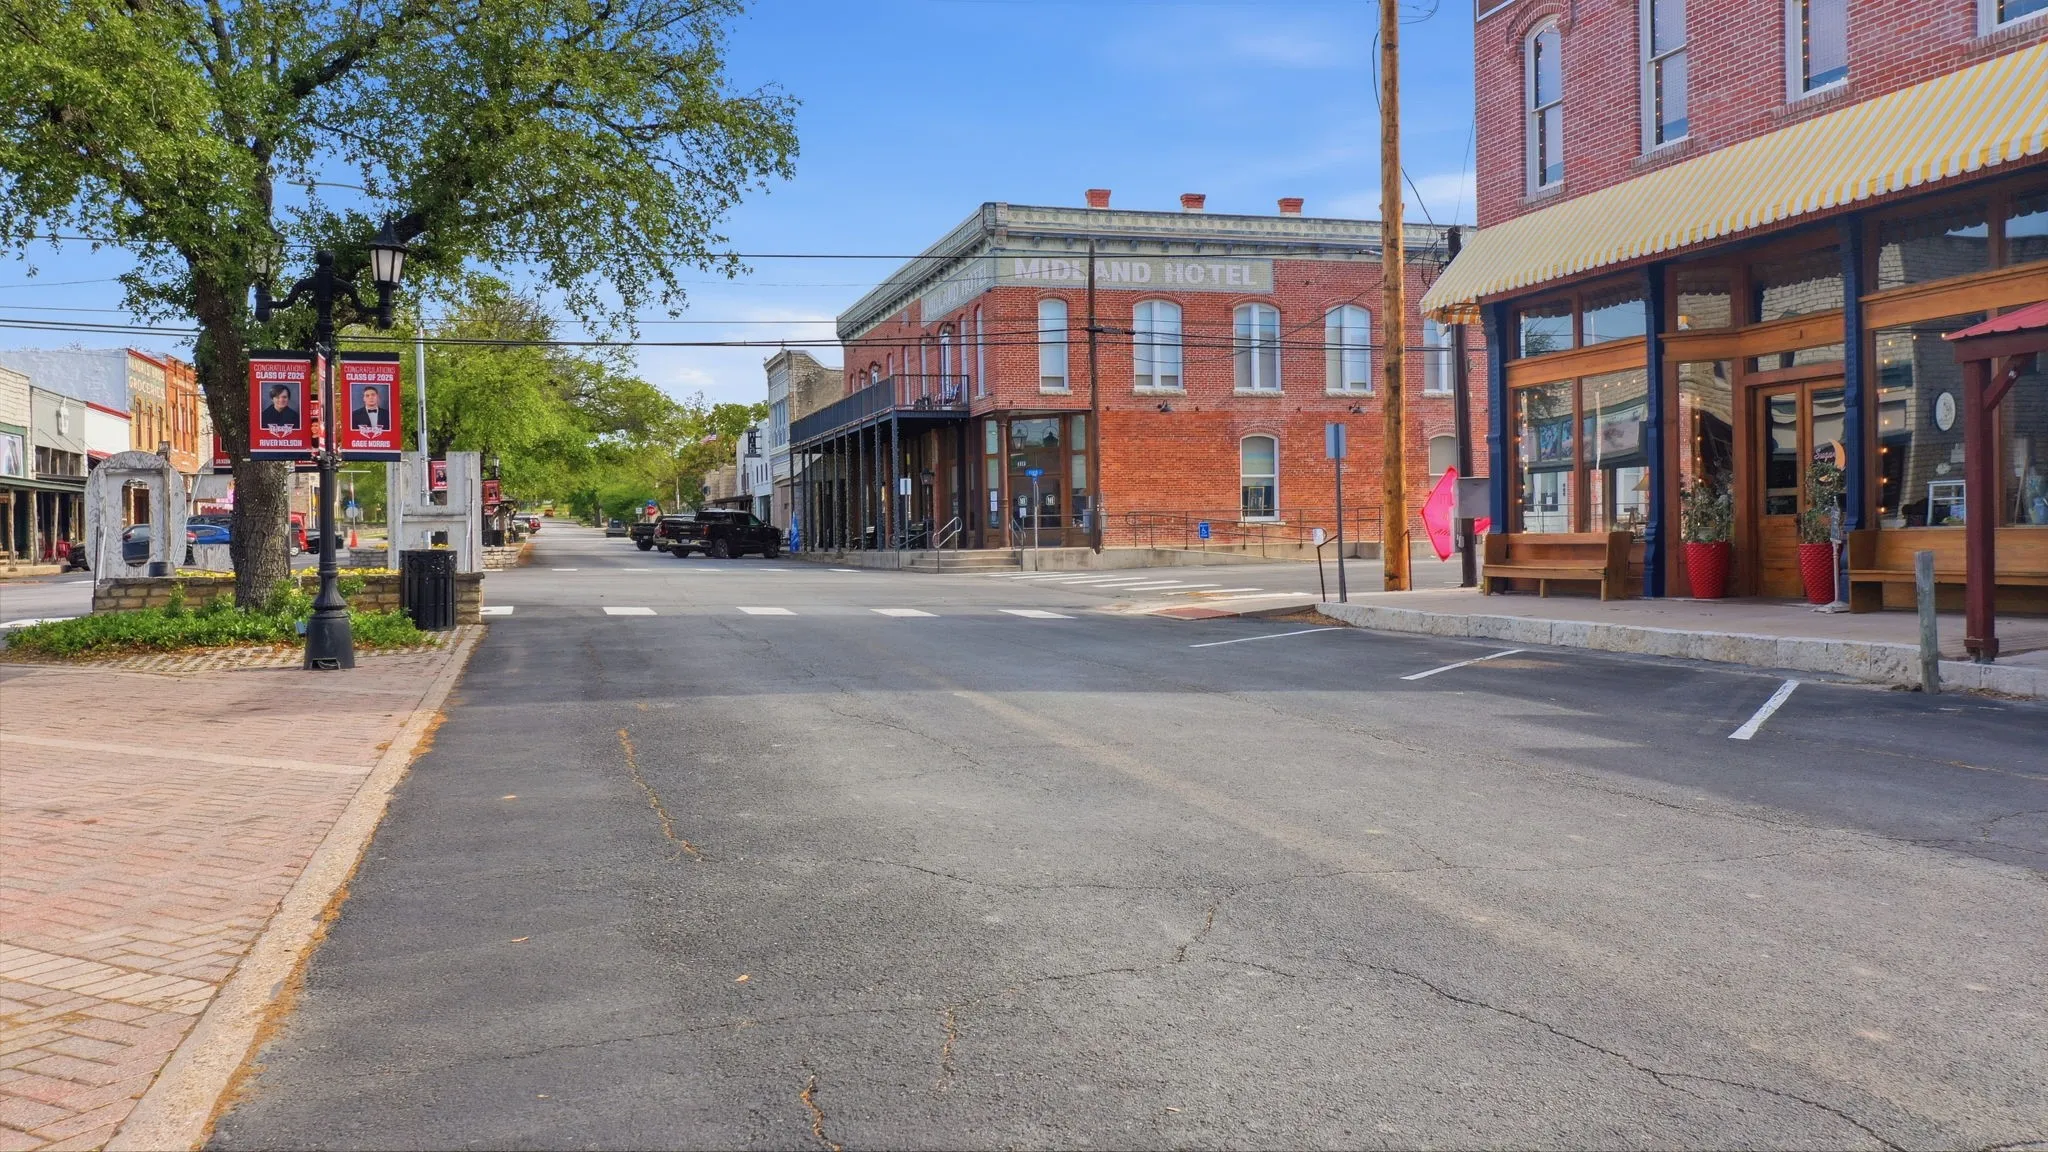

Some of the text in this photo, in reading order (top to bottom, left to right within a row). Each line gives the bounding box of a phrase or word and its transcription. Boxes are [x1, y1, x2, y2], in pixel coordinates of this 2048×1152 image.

[1015, 258, 1257, 286] MIDLAND HOTEL
[255, 371, 277, 379] CLASS
[277, 371, 287, 379] OF
[346, 373, 367, 381] CLASS
[367, 373, 377, 381] OF
